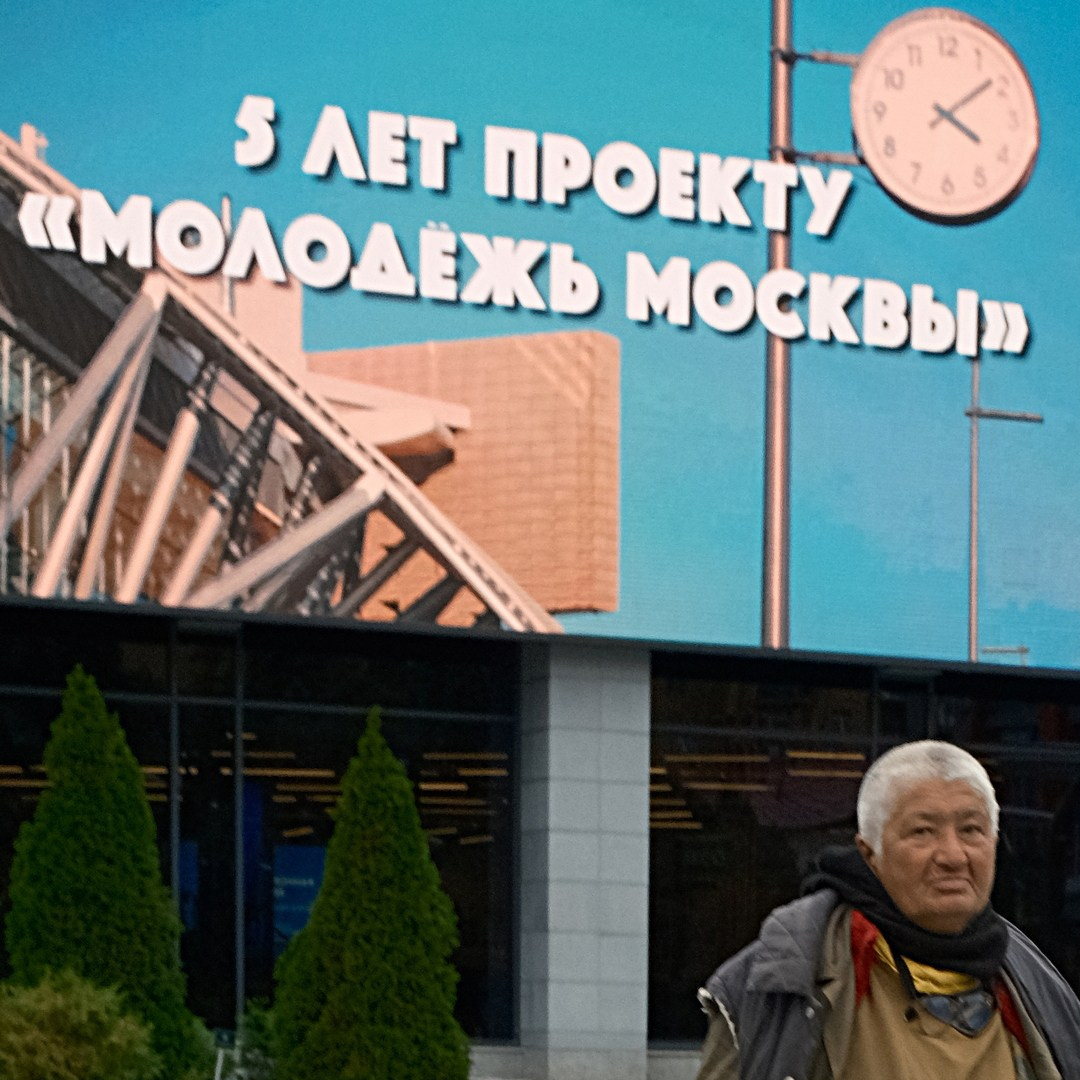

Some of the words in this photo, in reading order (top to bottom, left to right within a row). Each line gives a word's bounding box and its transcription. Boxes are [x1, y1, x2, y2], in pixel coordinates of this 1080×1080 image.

[234, 95, 277, 167] 5
[301, 104, 458, 190] ЛЕТ
[484, 124, 854, 237] ПРОЕКТУ
[18, 189, 601, 316] «МОЛОДЁЖЬ
[625, 250, 1031, 357] МОСКВЫ»
